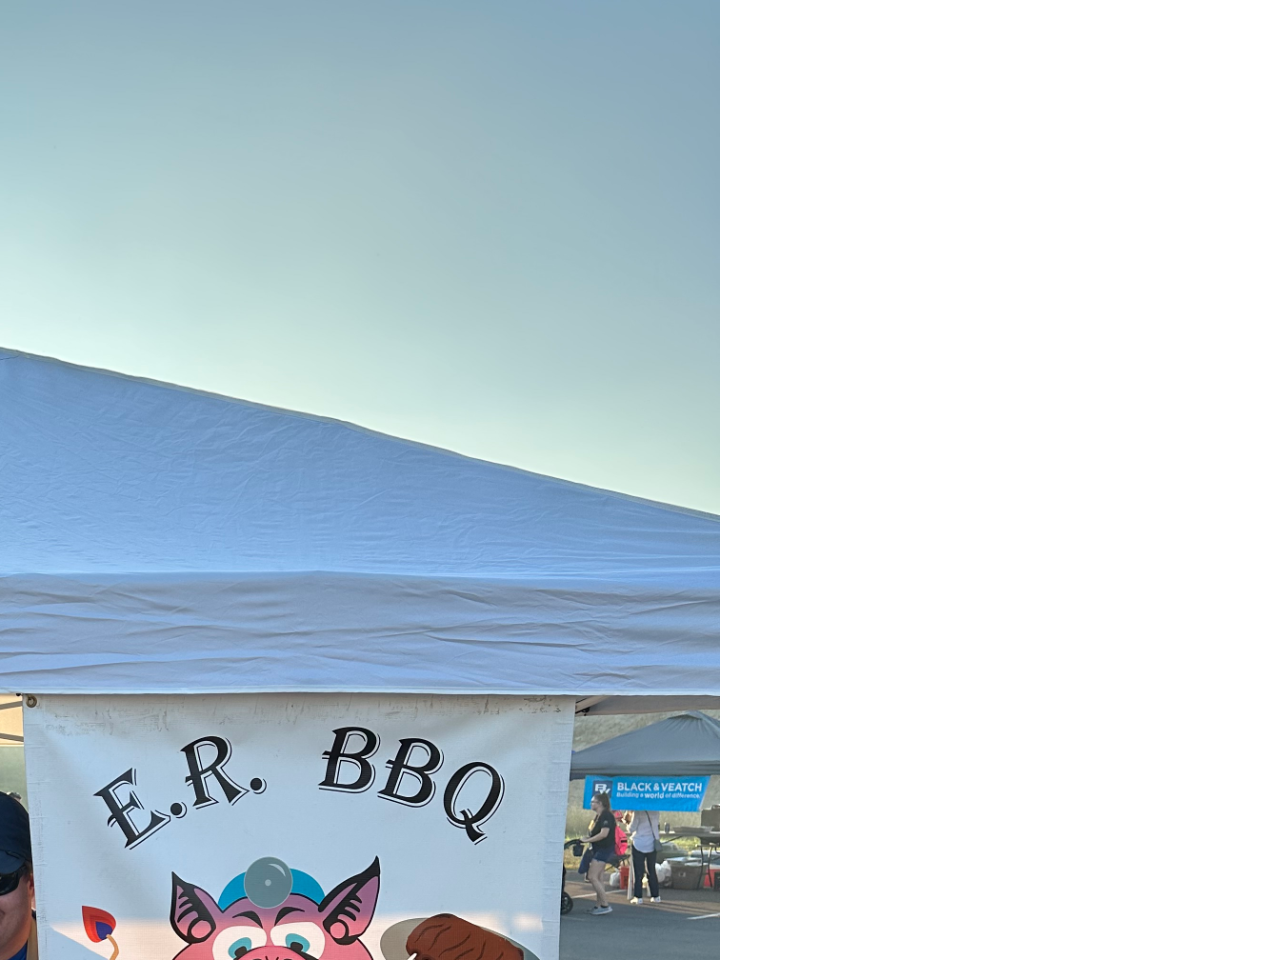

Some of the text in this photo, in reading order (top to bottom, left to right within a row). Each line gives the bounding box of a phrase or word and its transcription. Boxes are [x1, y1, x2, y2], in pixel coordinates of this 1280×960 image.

[92, 726, 506, 850] E.R. BBQ
[617, 782, 702, 792] BLACK & VEATCH
